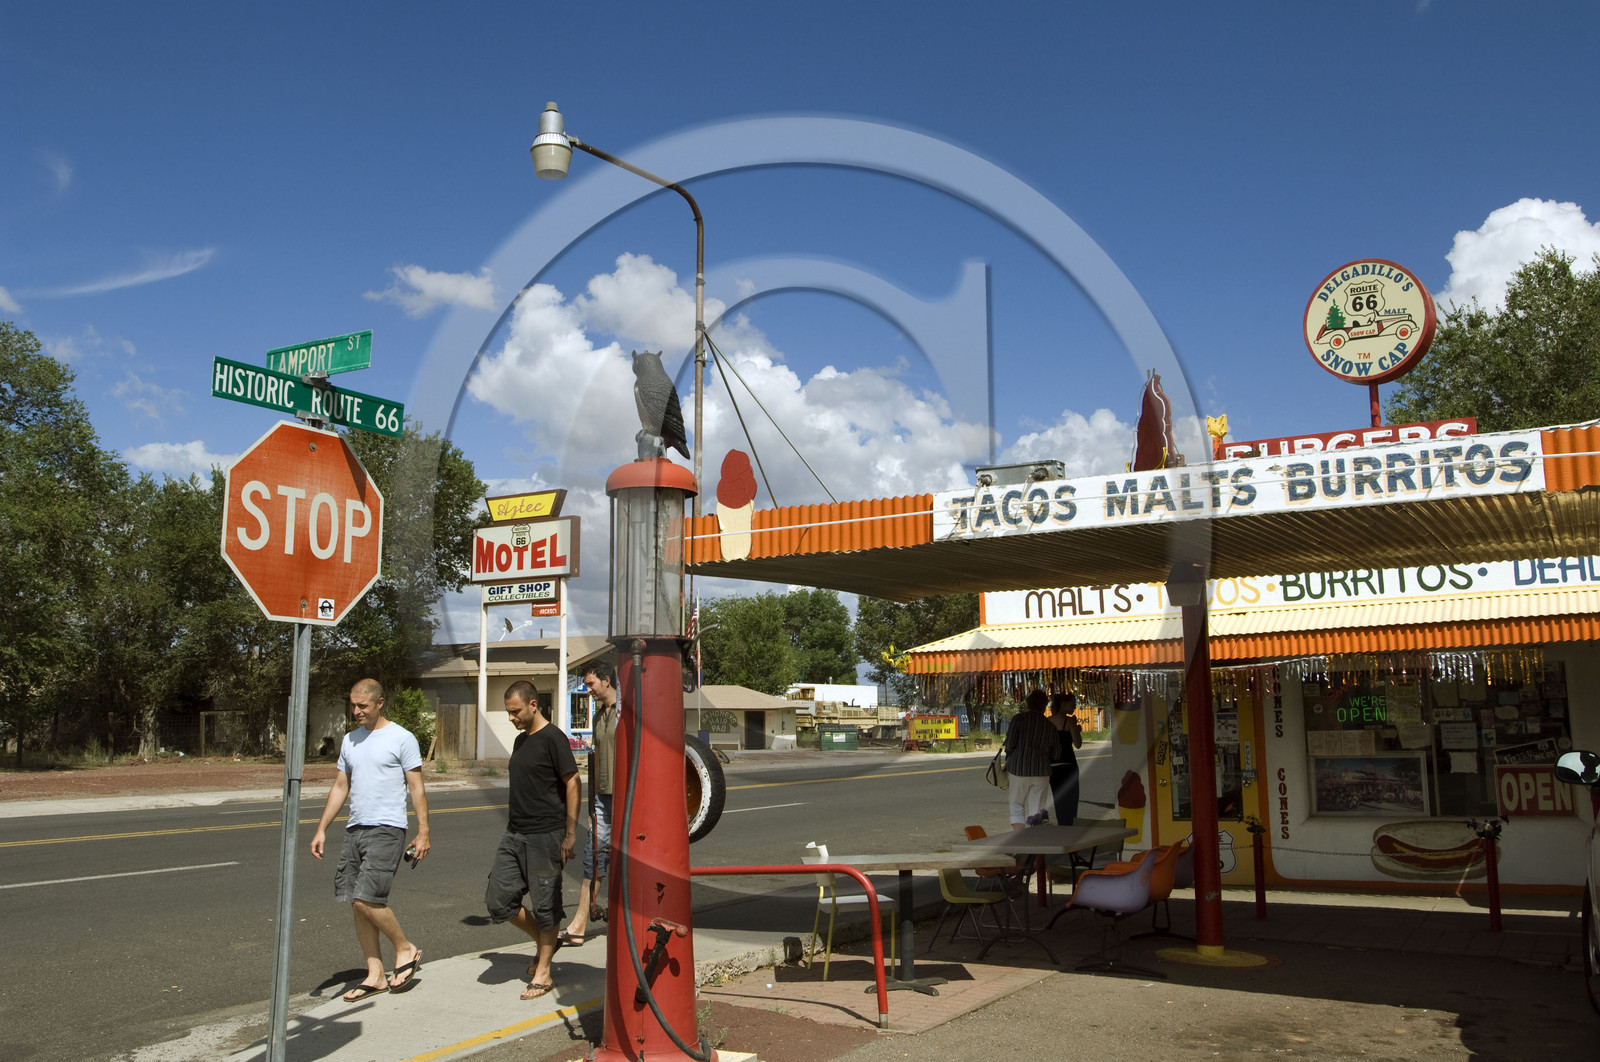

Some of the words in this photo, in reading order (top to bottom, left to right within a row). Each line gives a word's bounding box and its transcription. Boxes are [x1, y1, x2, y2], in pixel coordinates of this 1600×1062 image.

[1317, 263, 1414, 302] DELGADILLO'S
[1349, 284, 1379, 294] ROUTE
[1352, 294, 1378, 312] 66
[1384, 307, 1407, 315] MALT
[269, 343, 335, 375] LAMPORT
[348, 335, 361, 351] ST
[1321, 349, 1373, 377] SNOW
[1378, 342, 1409, 371] CAP
[214, 362, 296, 409] HISTORIC
[311, 386, 363, 425] ROUTE
[375, 404, 400, 432] 66
[950, 484, 1078, 532] TACOS
[1103, 466, 1257, 520] MALTS
[1284, 440, 1533, 502] BURRITOS
[236, 480, 372, 564] STOP
[497, 499, 545, 519] Aztec
[475, 533, 567, 574] MOTEL
[516, 537, 526, 545] 66
[488, 585, 513, 596] GIFT
[518, 582, 551, 593] SHOP
[488, 591, 550, 602] COLLECTIBLES
[1025, 584, 1132, 619] MALTS
[1148, 576, 1261, 609] TOS
[1279, 564, 1474, 602] BURRITOS
[1272, 666, 1284, 738] CONES
[1337, 707, 1386, 722] OPEN
[1349, 695, 1386, 707] WE'RE
[710, 717, 728, 726] HAIR
[1277, 767, 1290, 840] CONES
[1501, 772, 1573, 811] OPEN
